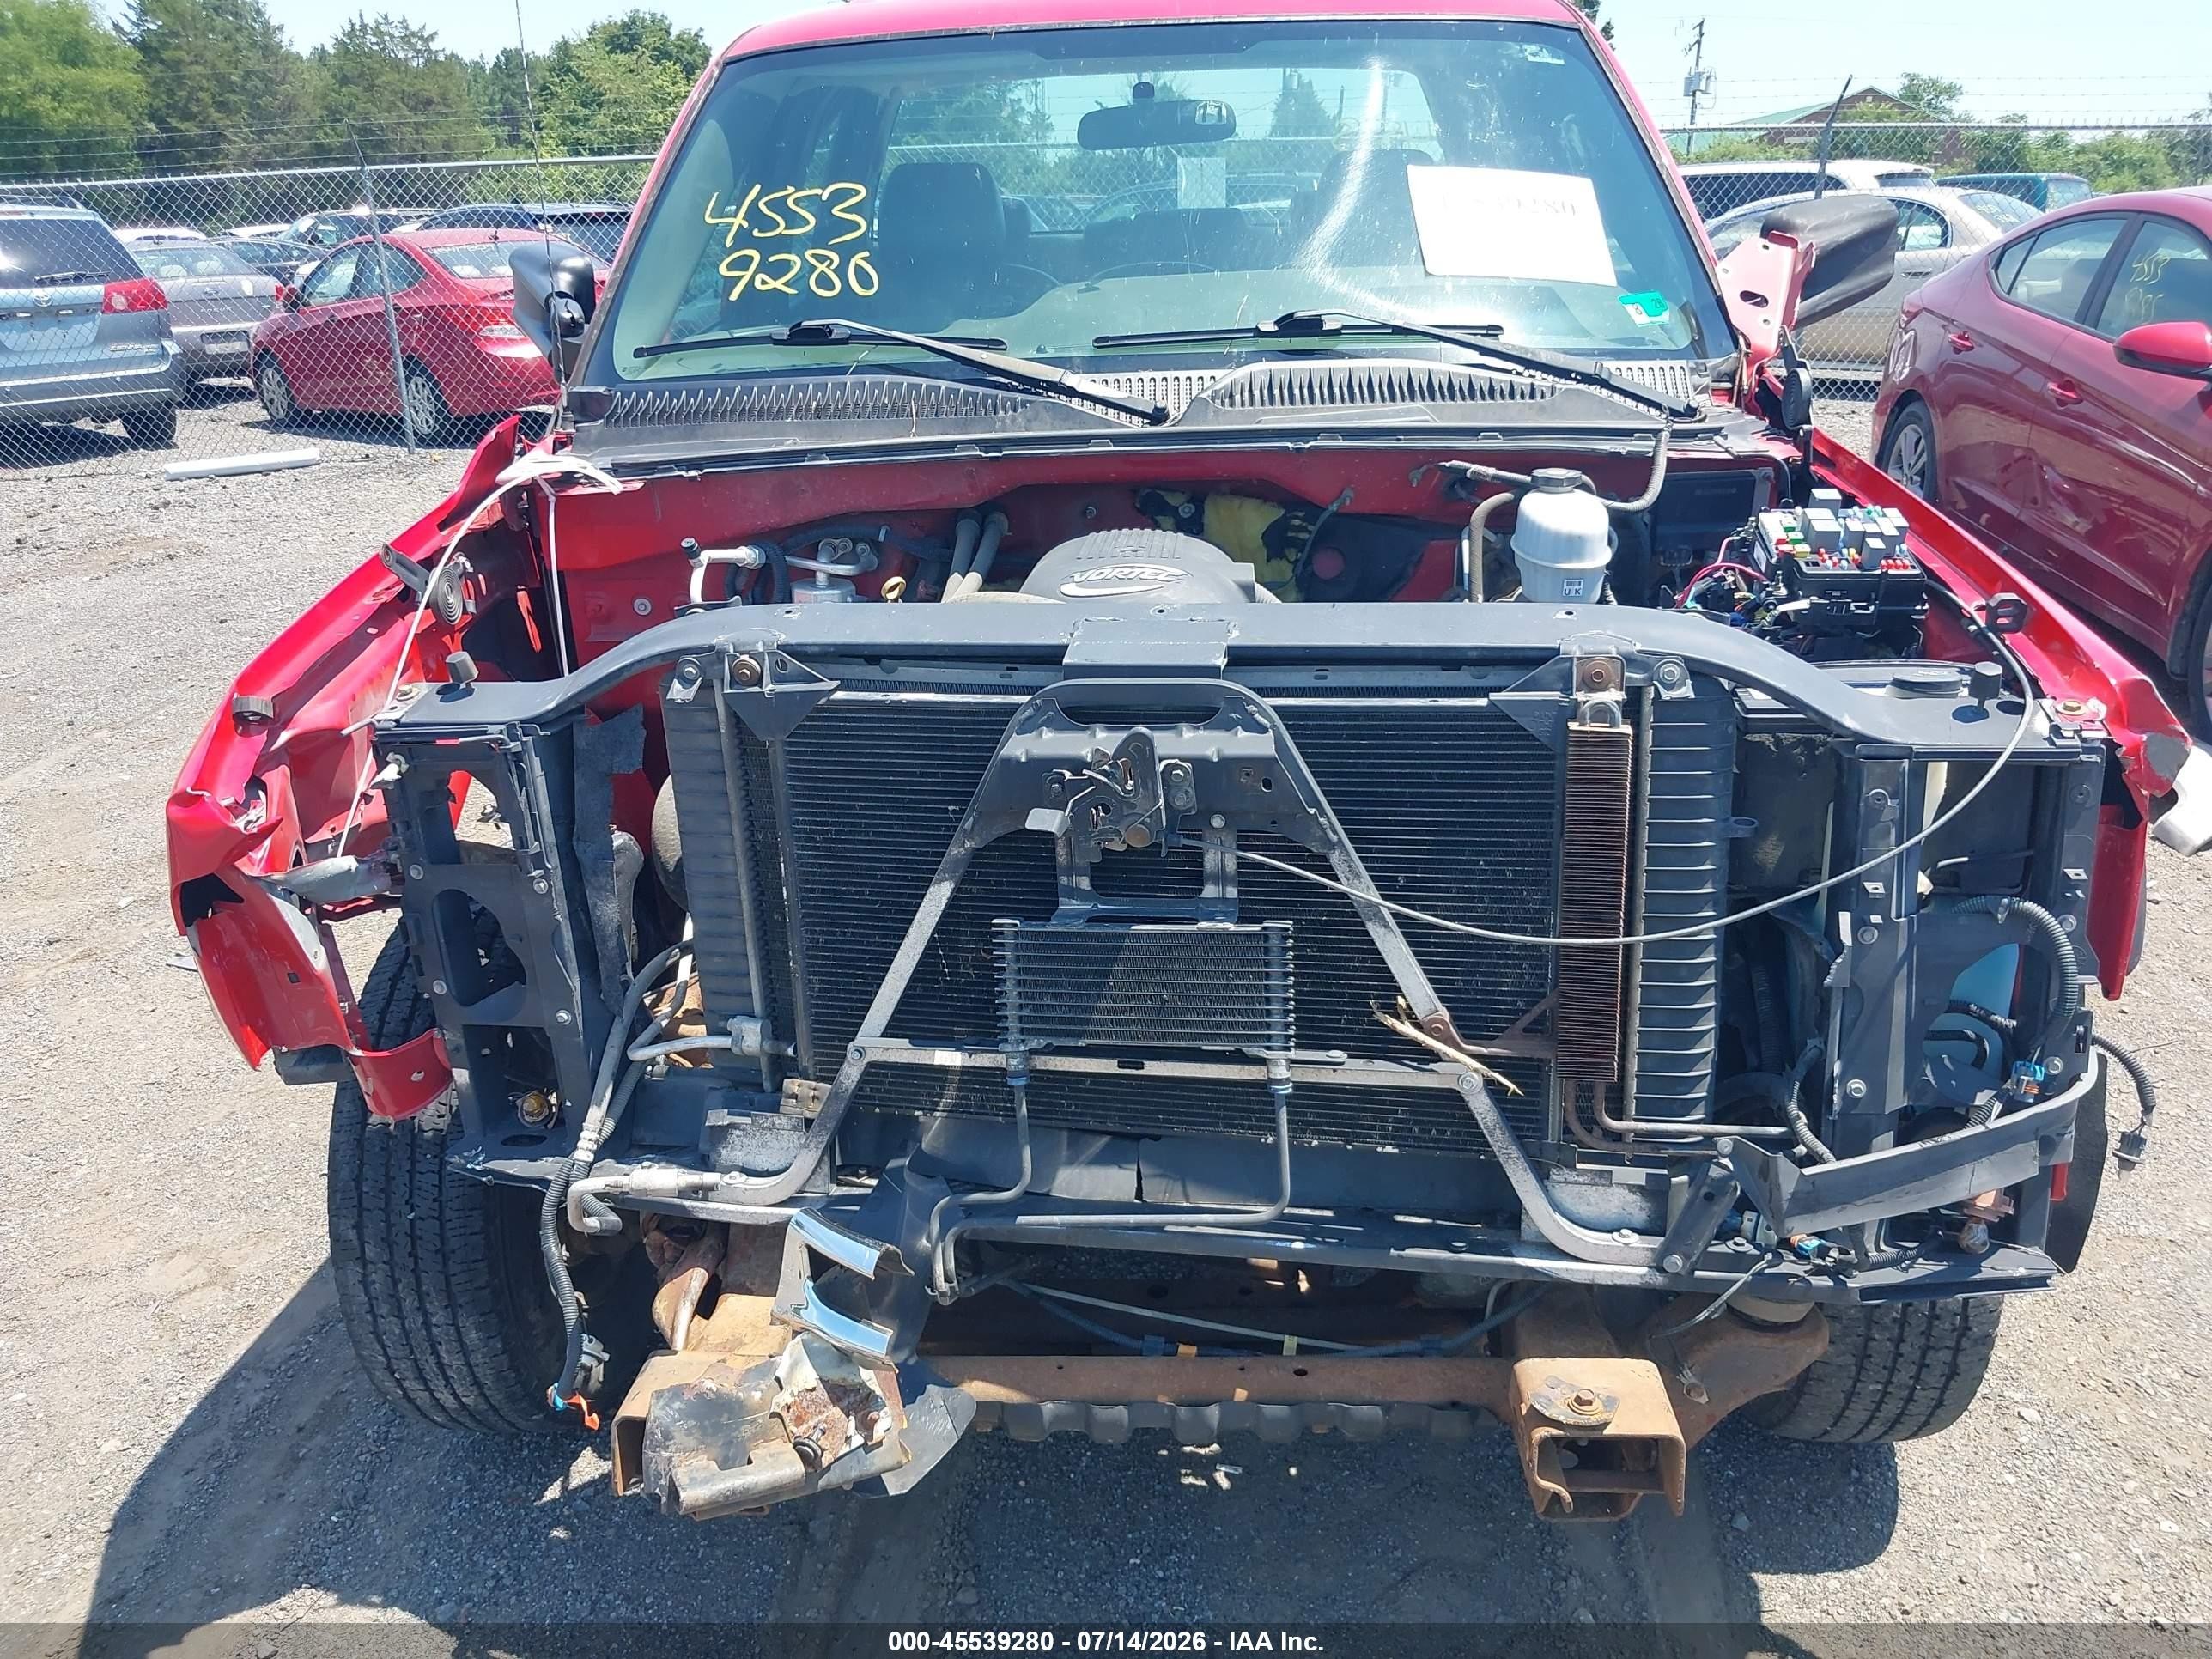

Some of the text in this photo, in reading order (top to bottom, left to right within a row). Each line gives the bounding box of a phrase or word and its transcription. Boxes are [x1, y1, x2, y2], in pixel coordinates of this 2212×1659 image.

[704, 182, 867, 248] 4553
[718, 248, 880, 301] 9280
[1070, 566, 1185, 584] VORTEC
